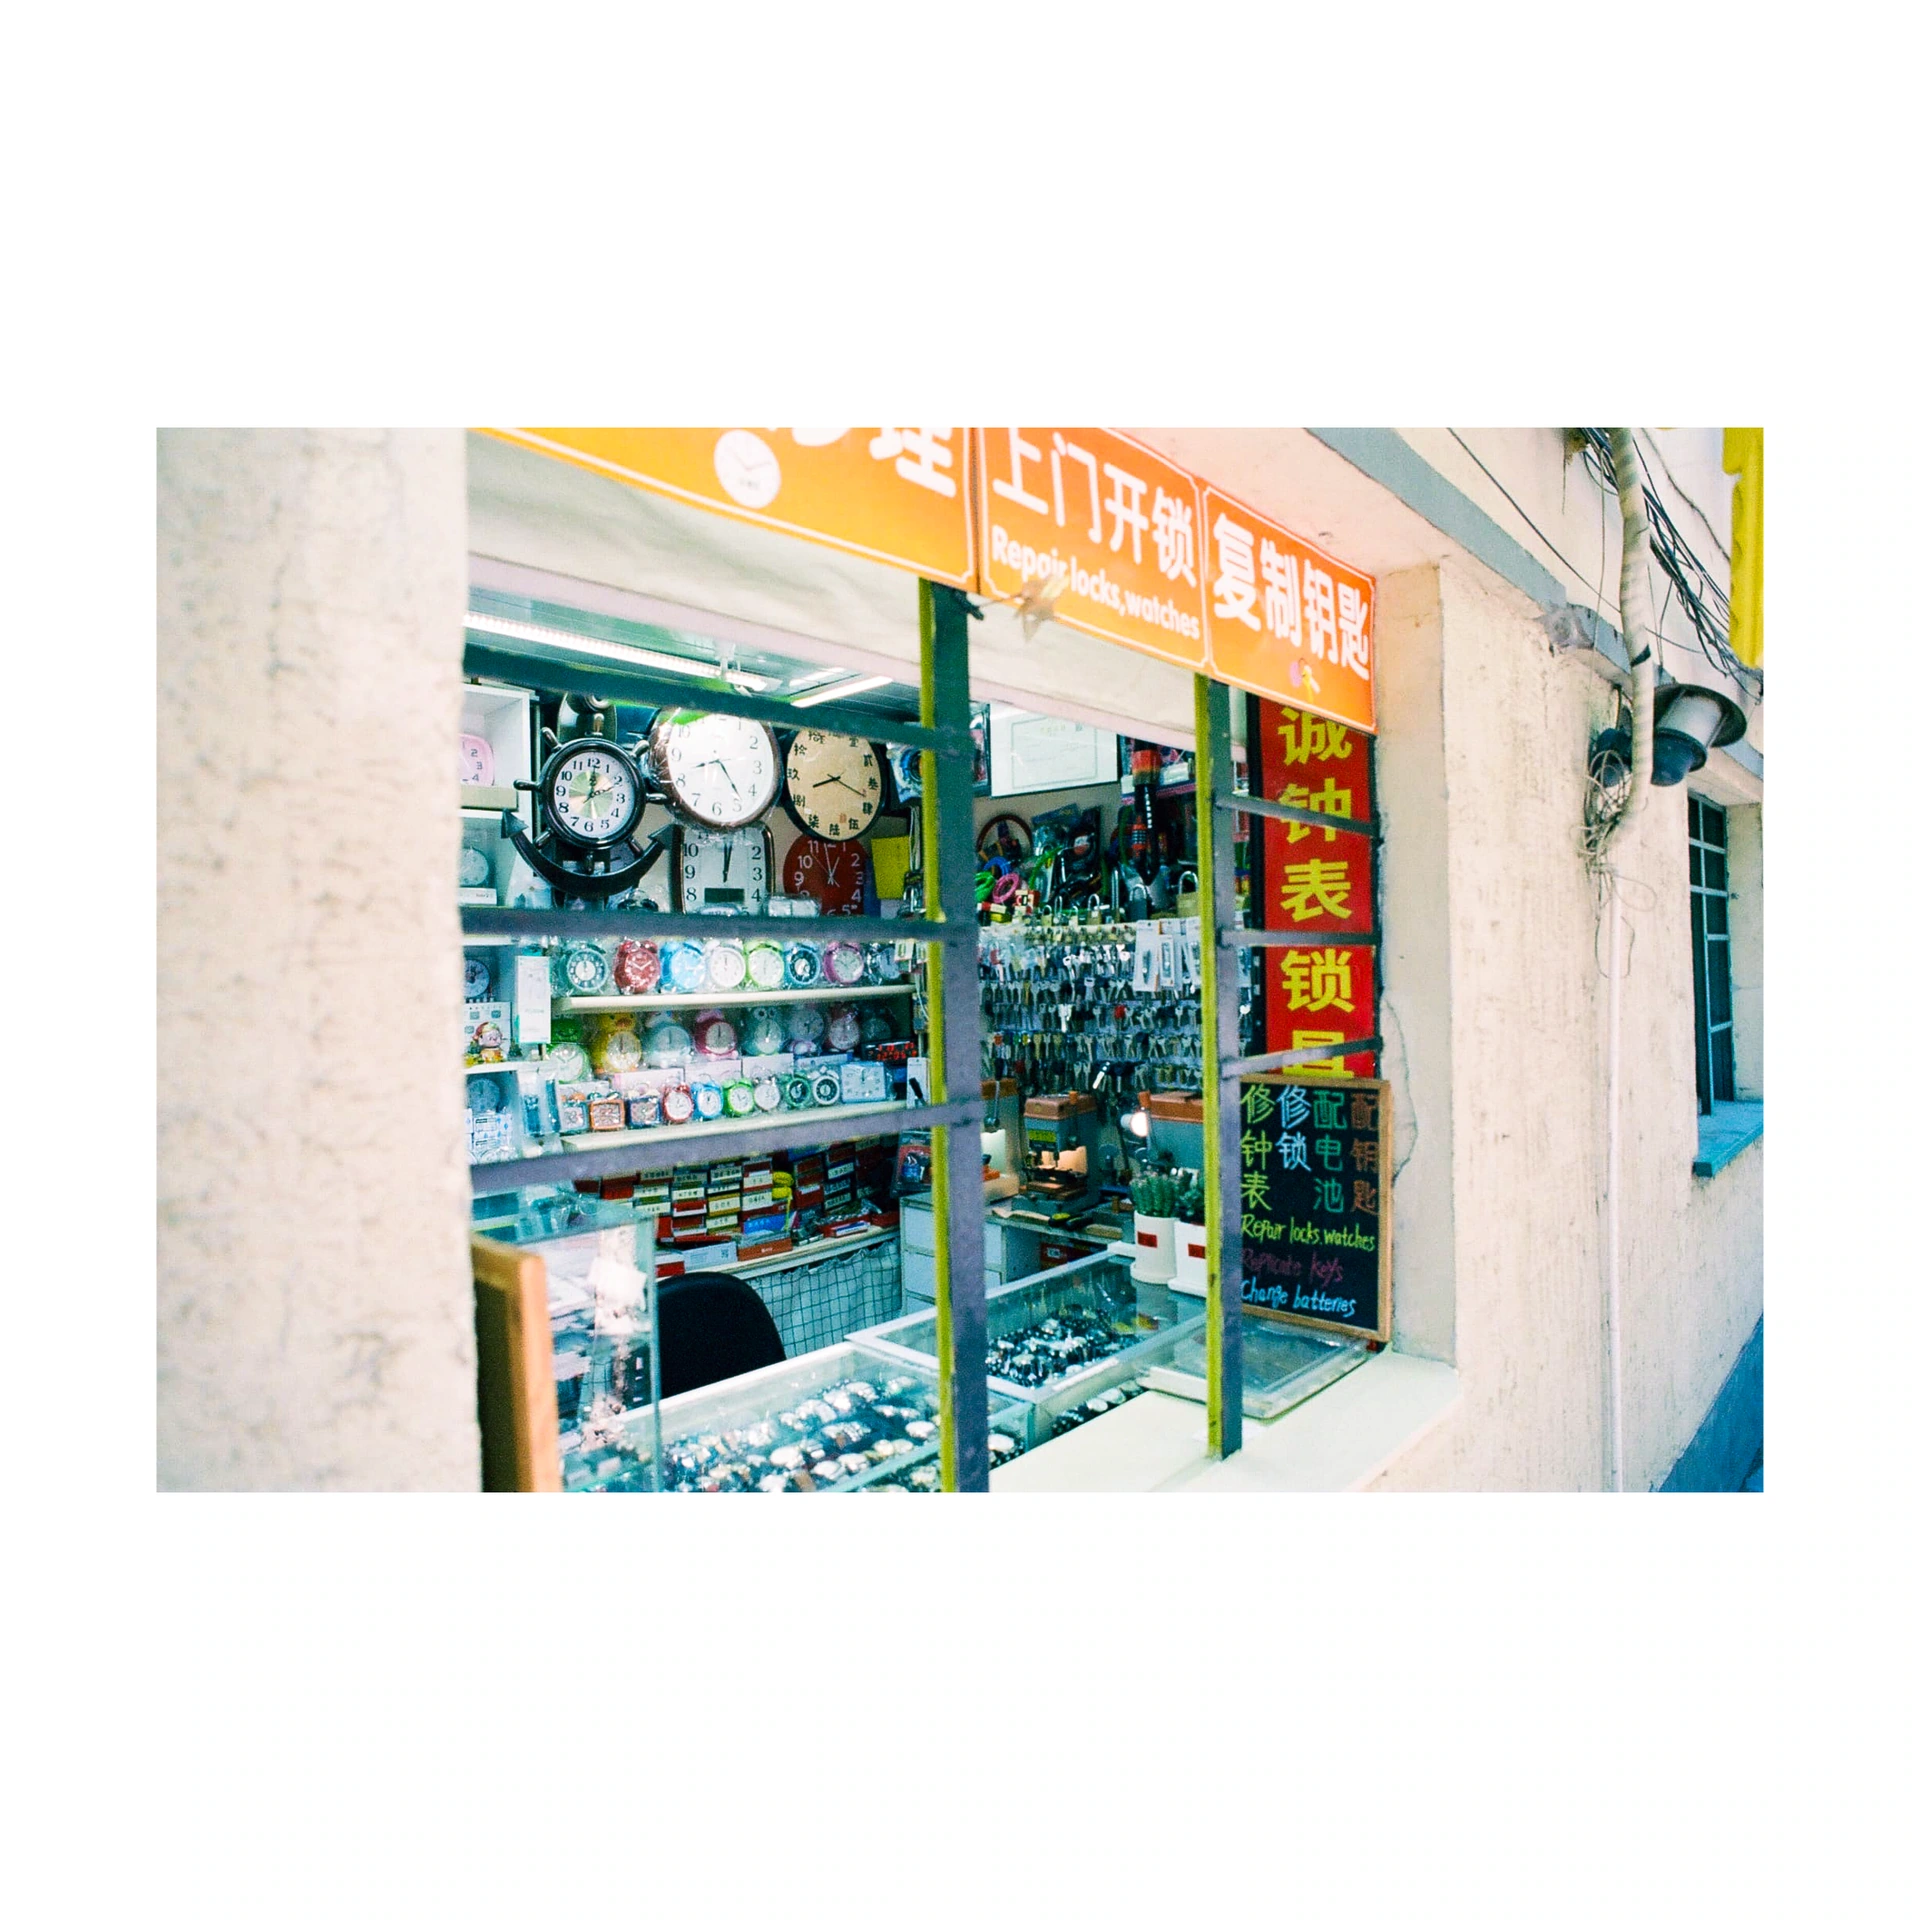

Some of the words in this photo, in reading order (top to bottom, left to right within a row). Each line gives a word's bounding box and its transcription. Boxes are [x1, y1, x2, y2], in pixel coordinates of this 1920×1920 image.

[993, 428, 1196, 587] 上门开锁
[992, 525, 1068, 582] Repair
[1213, 513, 1370, 680] 复制钥匙
[749, 736, 758, 749] 2
[671, 748, 682, 761] 9
[573, 761, 582, 770] 11
[587, 758, 600, 768] 12
[753, 760, 762, 775] 3
[561, 771, 572, 781] 10
[614, 776, 622, 786] 2
[676, 773, 686, 788] 8
[556, 786, 566, 797] 9
[748, 784, 757, 796] 4
[616, 793, 625, 804] 3
[692, 793, 701, 806] 7
[732, 798, 742, 812] 5
[559, 802, 569, 813] 8
[611, 808, 619, 818] 4
[712, 802, 722, 816] 6
[570, 817, 580, 826] 7
[584, 821, 594, 832] 6
[601, 820, 610, 829] 5
[684, 843, 698, 857] 10
[752, 846, 761, 860] 2
[808, 840, 819, 853] 11
[797, 855, 813, 869] 10
[851, 853, 860, 867] 2
[685, 865, 696, 879] 9
[753, 867, 762, 881] 3
[794, 871, 804, 886] 9
[856, 871, 863, 885] 3
[686, 887, 697, 901] 8
[751, 888, 761, 902] 4
[851, 889, 862, 902] 4
[1275, 1085, 1312, 1171] 修锁
[1240, 1083, 1275, 1210] 修钟表
[1313, 1090, 1347, 1213] 配电池
[1351, 1093, 1379, 1215] 配钥匙
[1242, 1214, 1286, 1243] Repair
[1310, 1252, 1343, 1288] keys
[1293, 1284, 1357, 1317] batteries
